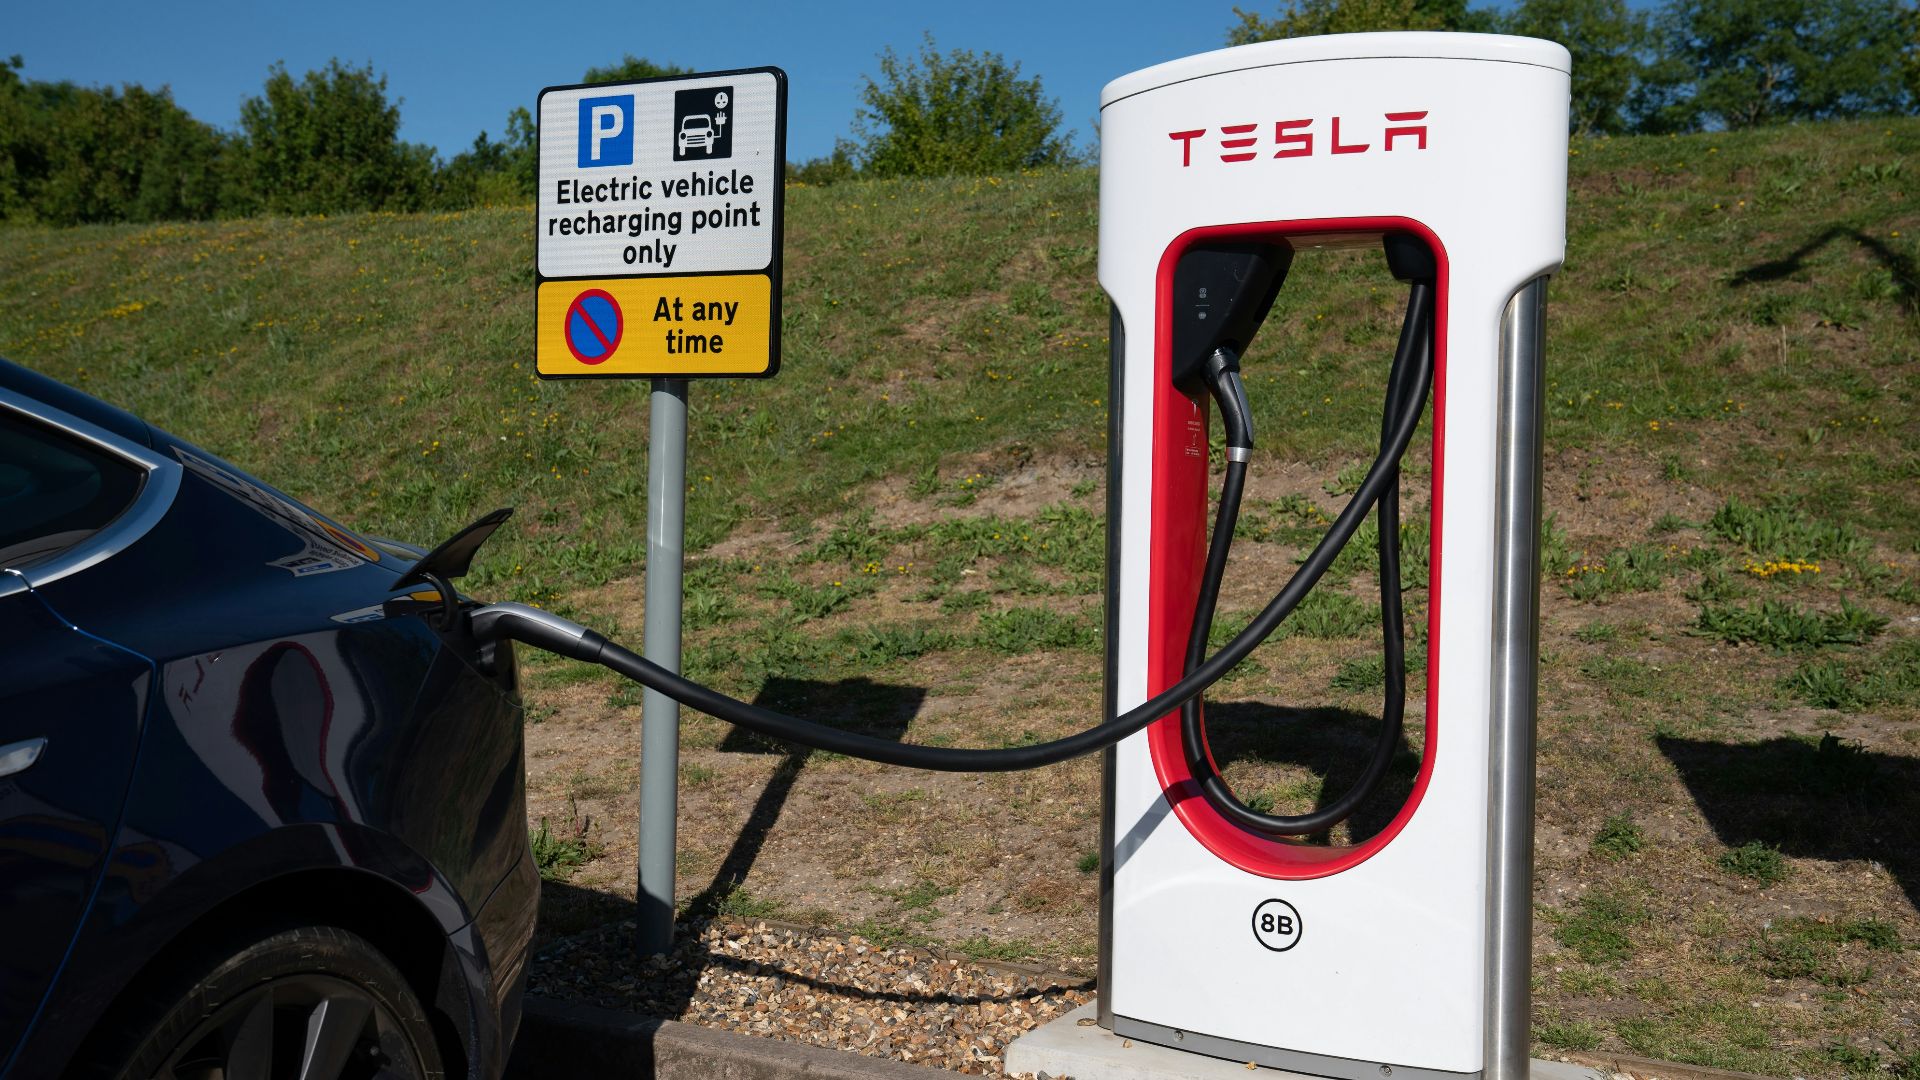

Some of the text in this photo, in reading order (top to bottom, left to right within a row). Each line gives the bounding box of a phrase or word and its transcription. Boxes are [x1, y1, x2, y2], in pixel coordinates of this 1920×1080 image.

[590, 104, 624, 161] P
[1168, 110, 1429, 168] TESLA
[557, 169, 754, 205] Electric vehicle
[549, 201, 761, 238] recharging point
[622, 238, 677, 268] only
[653, 296, 739, 326] At any
[665, 328, 724, 354] time
[1260, 913, 1294, 936] 8B
